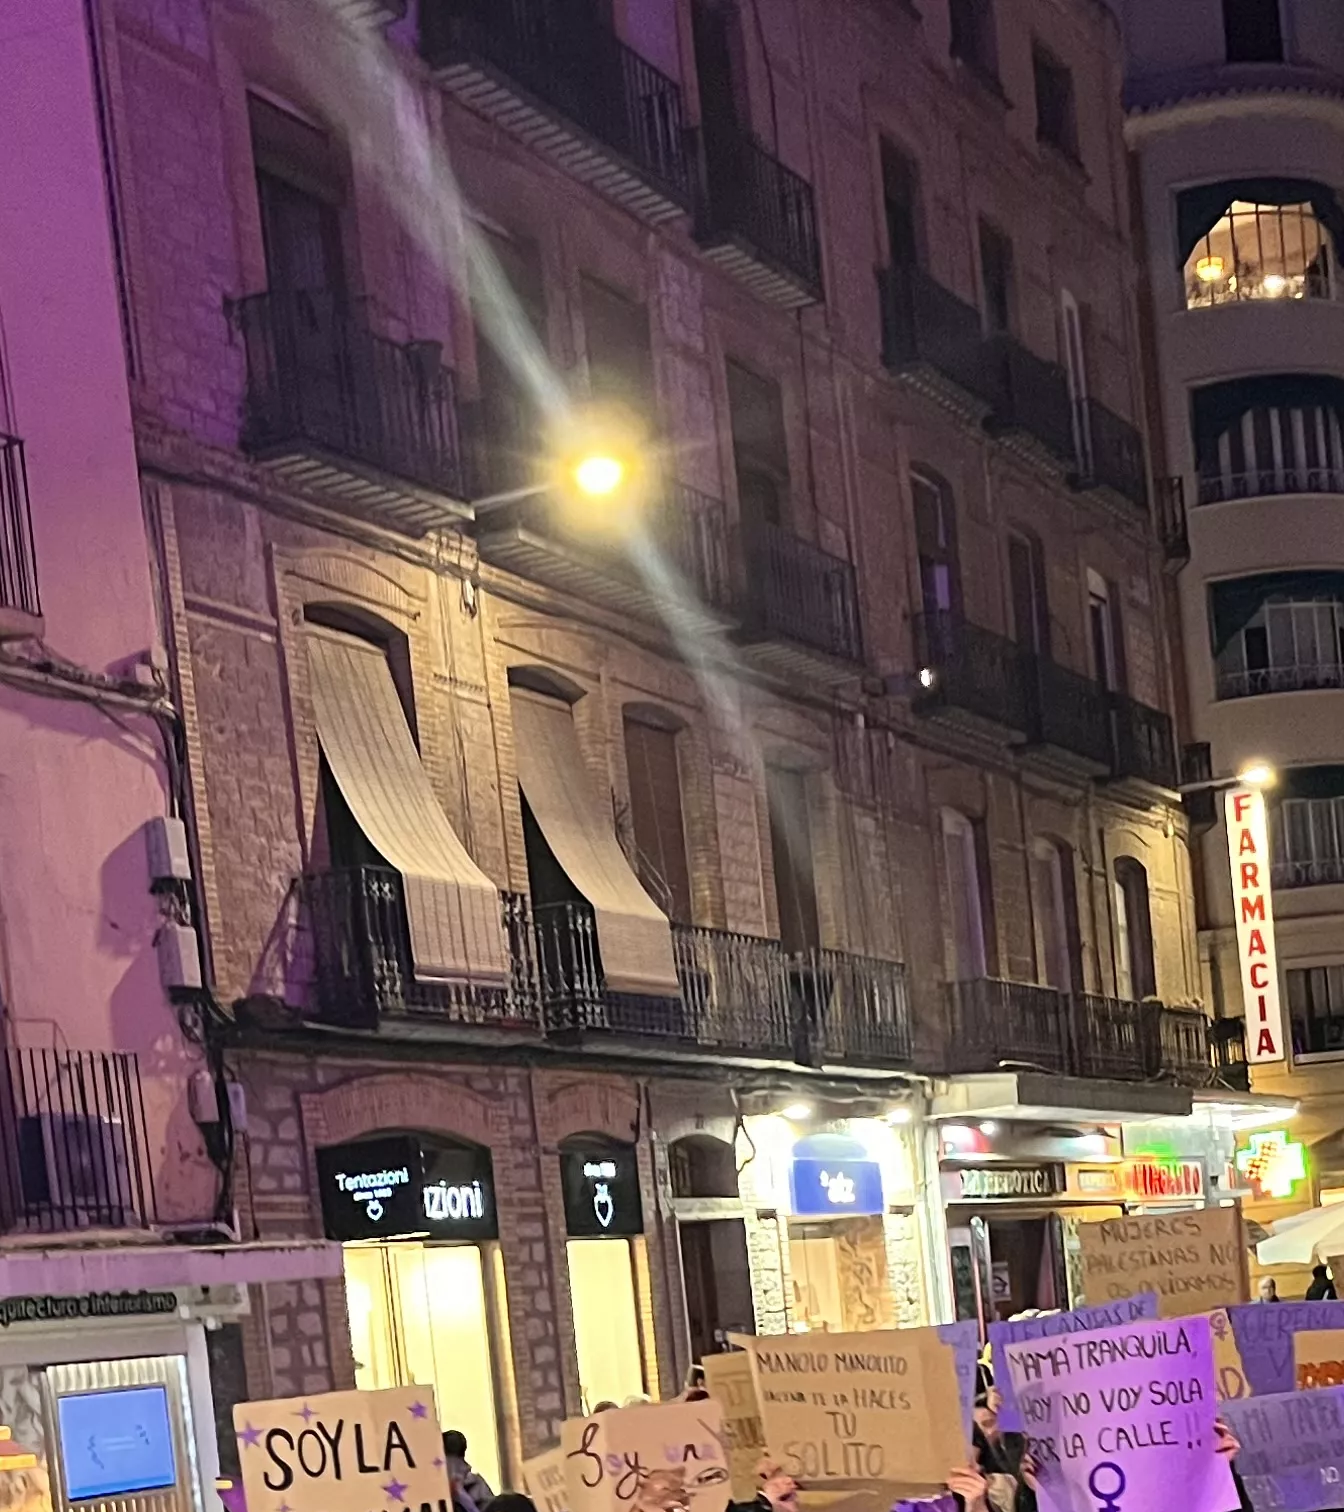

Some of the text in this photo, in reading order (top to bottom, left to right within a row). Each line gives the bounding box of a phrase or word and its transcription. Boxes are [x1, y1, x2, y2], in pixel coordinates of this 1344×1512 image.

[1233, 793, 1276, 1057] FARMACIA
[335, 1167, 409, 1191] Tentazioni
[423, 1180, 484, 1220] zioni
[1100, 1215, 1202, 1245] MUJERES
[1086, 1245, 1200, 1276] PALESTINAS
[852, 1386, 912, 1411] HACES
[1062, 1391, 1091, 1418] NO
[1099, 1385, 1143, 1413] VOY
[1149, 1376, 1204, 1407] SOLA
[263, 1420, 416, 1494] SOY LA
[784, 1438, 886, 1479] SOLITO
[1062, 1432, 1086, 1458] LA
[1097, 1420, 1179, 1453] CALLE
